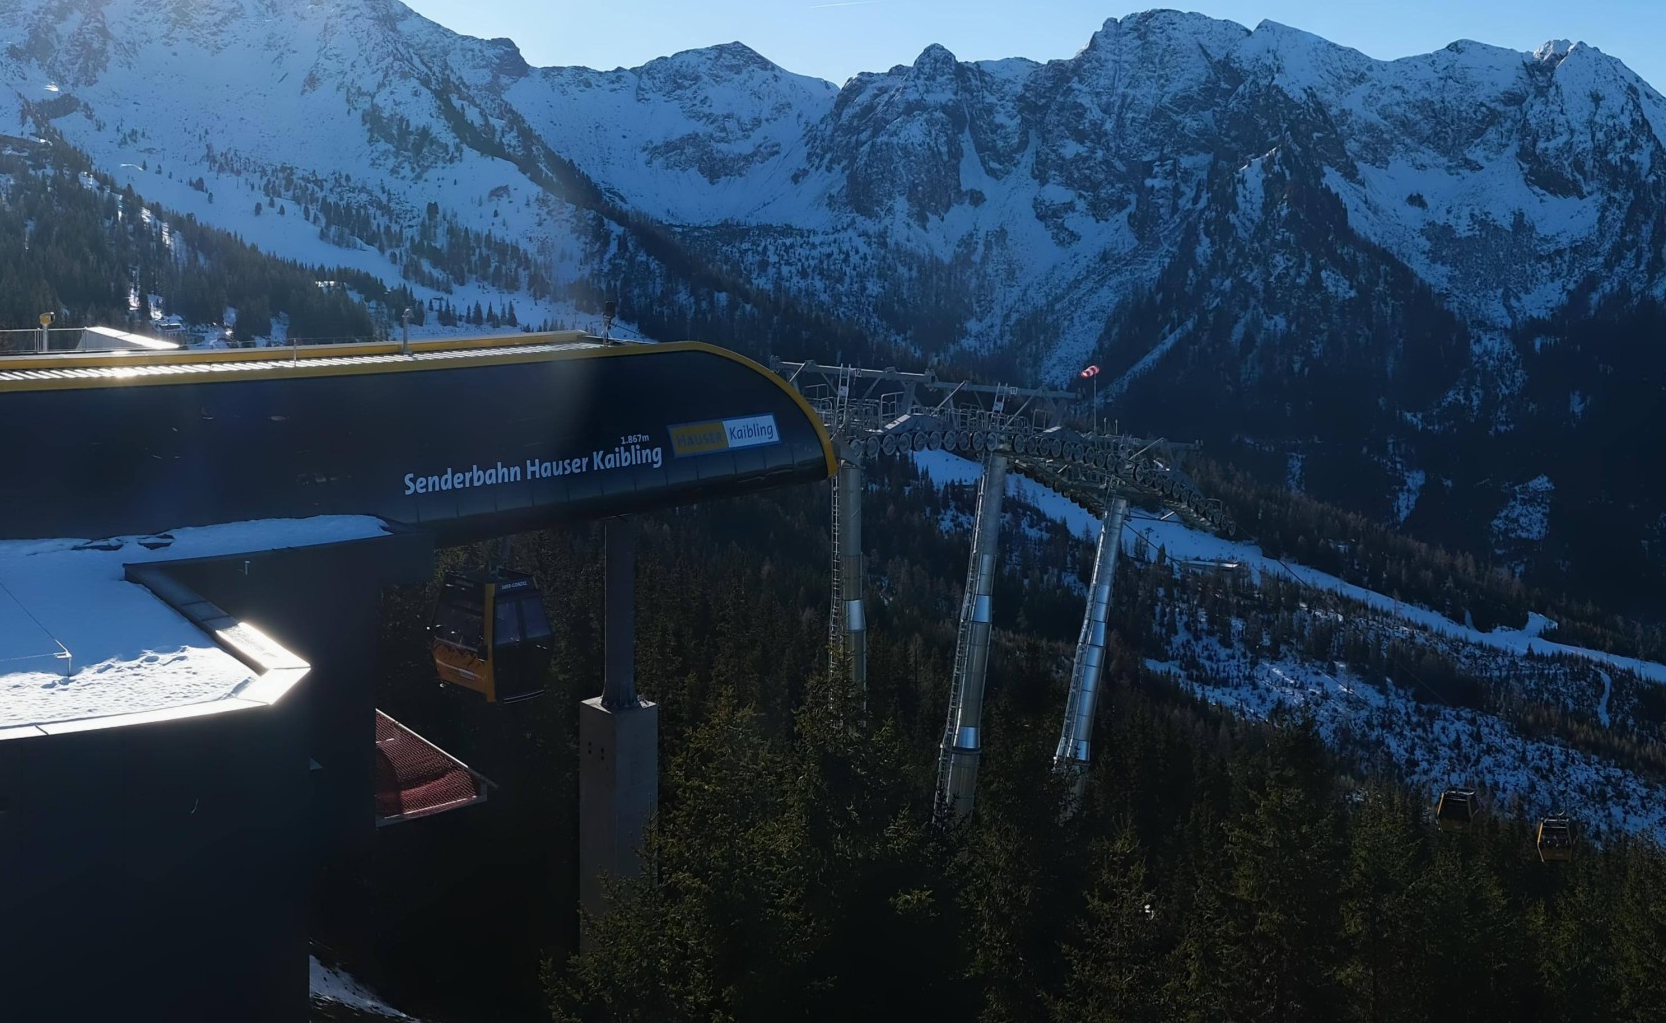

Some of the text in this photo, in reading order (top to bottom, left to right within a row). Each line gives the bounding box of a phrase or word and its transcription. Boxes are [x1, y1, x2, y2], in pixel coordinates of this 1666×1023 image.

[620, 434, 650, 445] 1.867m
[676, 423, 774, 447] HAUSER Kaibling
[404, 444, 663, 496] Senderbahn Hauser Kaibling
